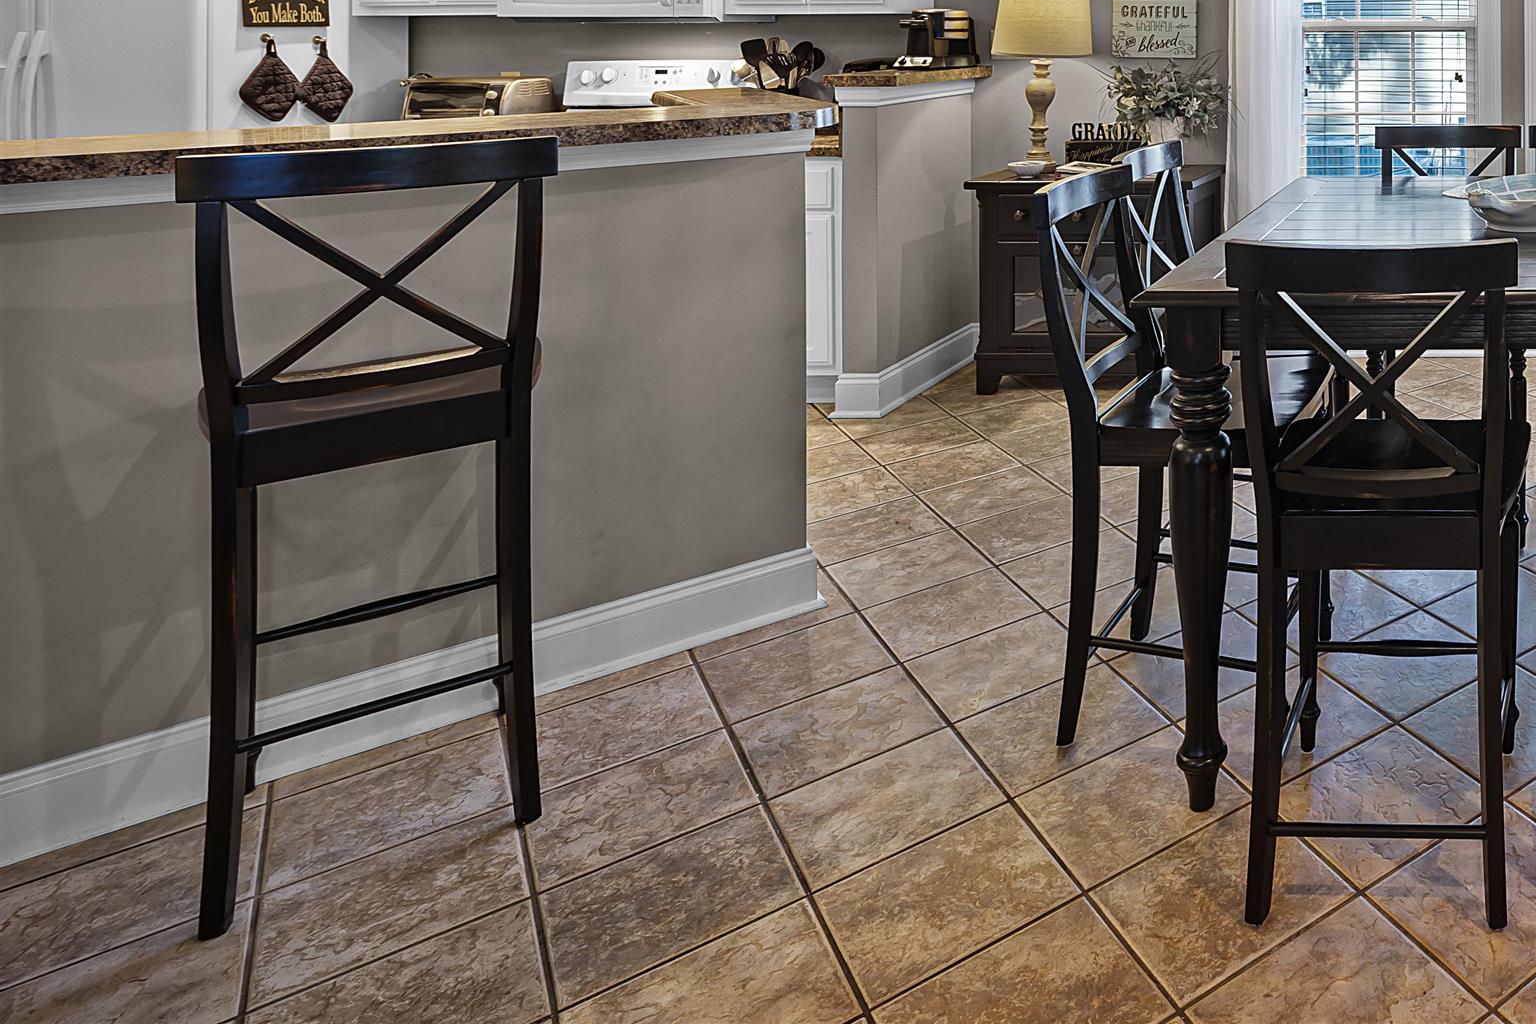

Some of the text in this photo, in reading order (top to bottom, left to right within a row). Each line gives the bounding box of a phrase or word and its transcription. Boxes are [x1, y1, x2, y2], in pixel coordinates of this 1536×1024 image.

[250, 2, 326, 23] You Make Both.
[1121, 5, 1188, 19] GRATEFUL
[1138, 31, 1180, 53] blessed
